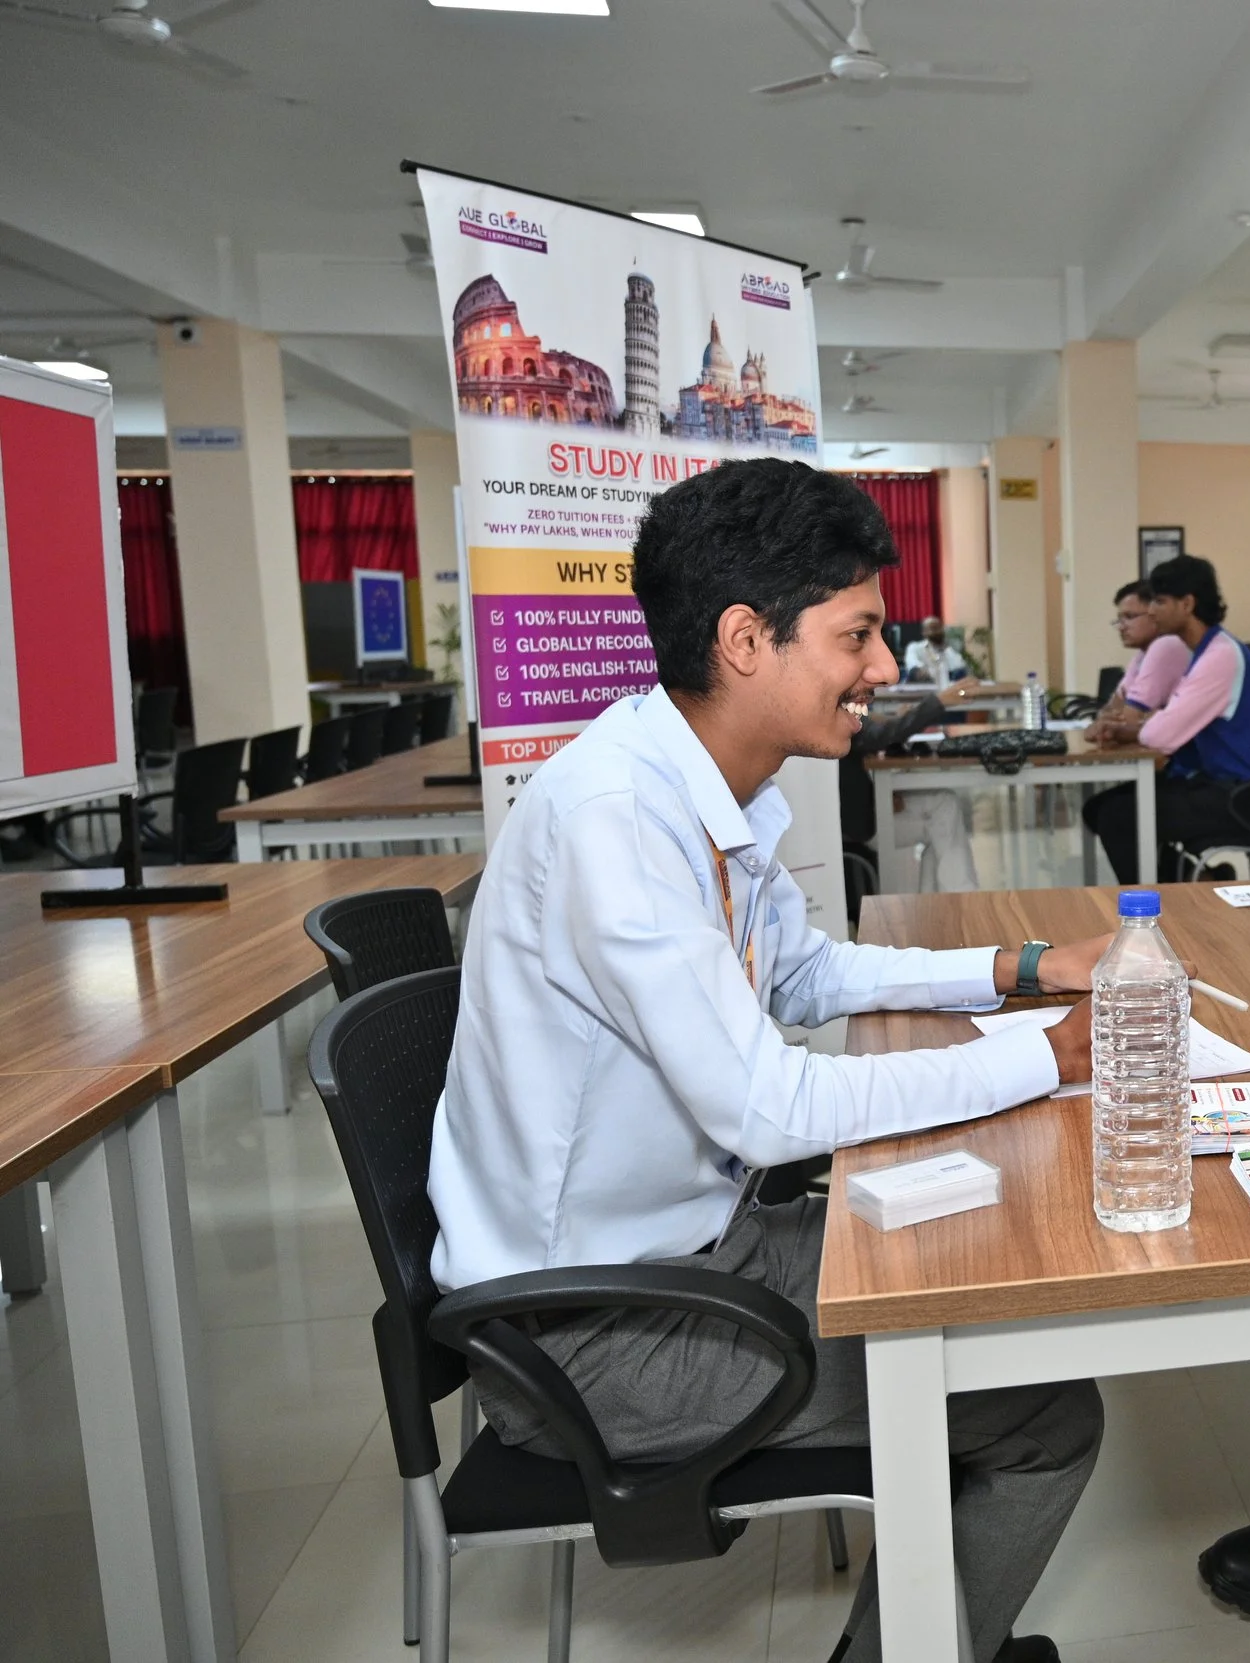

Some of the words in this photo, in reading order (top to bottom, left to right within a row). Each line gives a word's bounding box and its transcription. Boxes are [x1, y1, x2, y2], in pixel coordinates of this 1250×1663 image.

[488, 210, 548, 239] GLOBAL
[741, 273, 790, 294] ABROAD
[550, 443, 644, 479] STUDY
[653, 454, 678, 482] IN
[483, 480, 525, 495] YOUR
[530, 482, 578, 499] DREAM
[581, 486, 598, 500] OF
[528, 509, 555, 520] ZERO
[557, 511, 599, 523] TUITION
[602, 514, 625, 525] FEES
[520, 524, 541, 535] PAY
[543, 526, 579, 538] LAKHS,
[581, 528, 612, 538] WHEN
[557, 562, 608, 583] WHY
[515, 610, 556, 626] 100%
[558, 610, 600, 625] FULLY
[516, 636, 593, 653] GLOBALLY
[520, 662, 560, 679] 100%
[521, 689, 579, 706] TRAVEL
[581, 685, 637, 702] ACROSS
[501, 742, 537, 760] TOP
